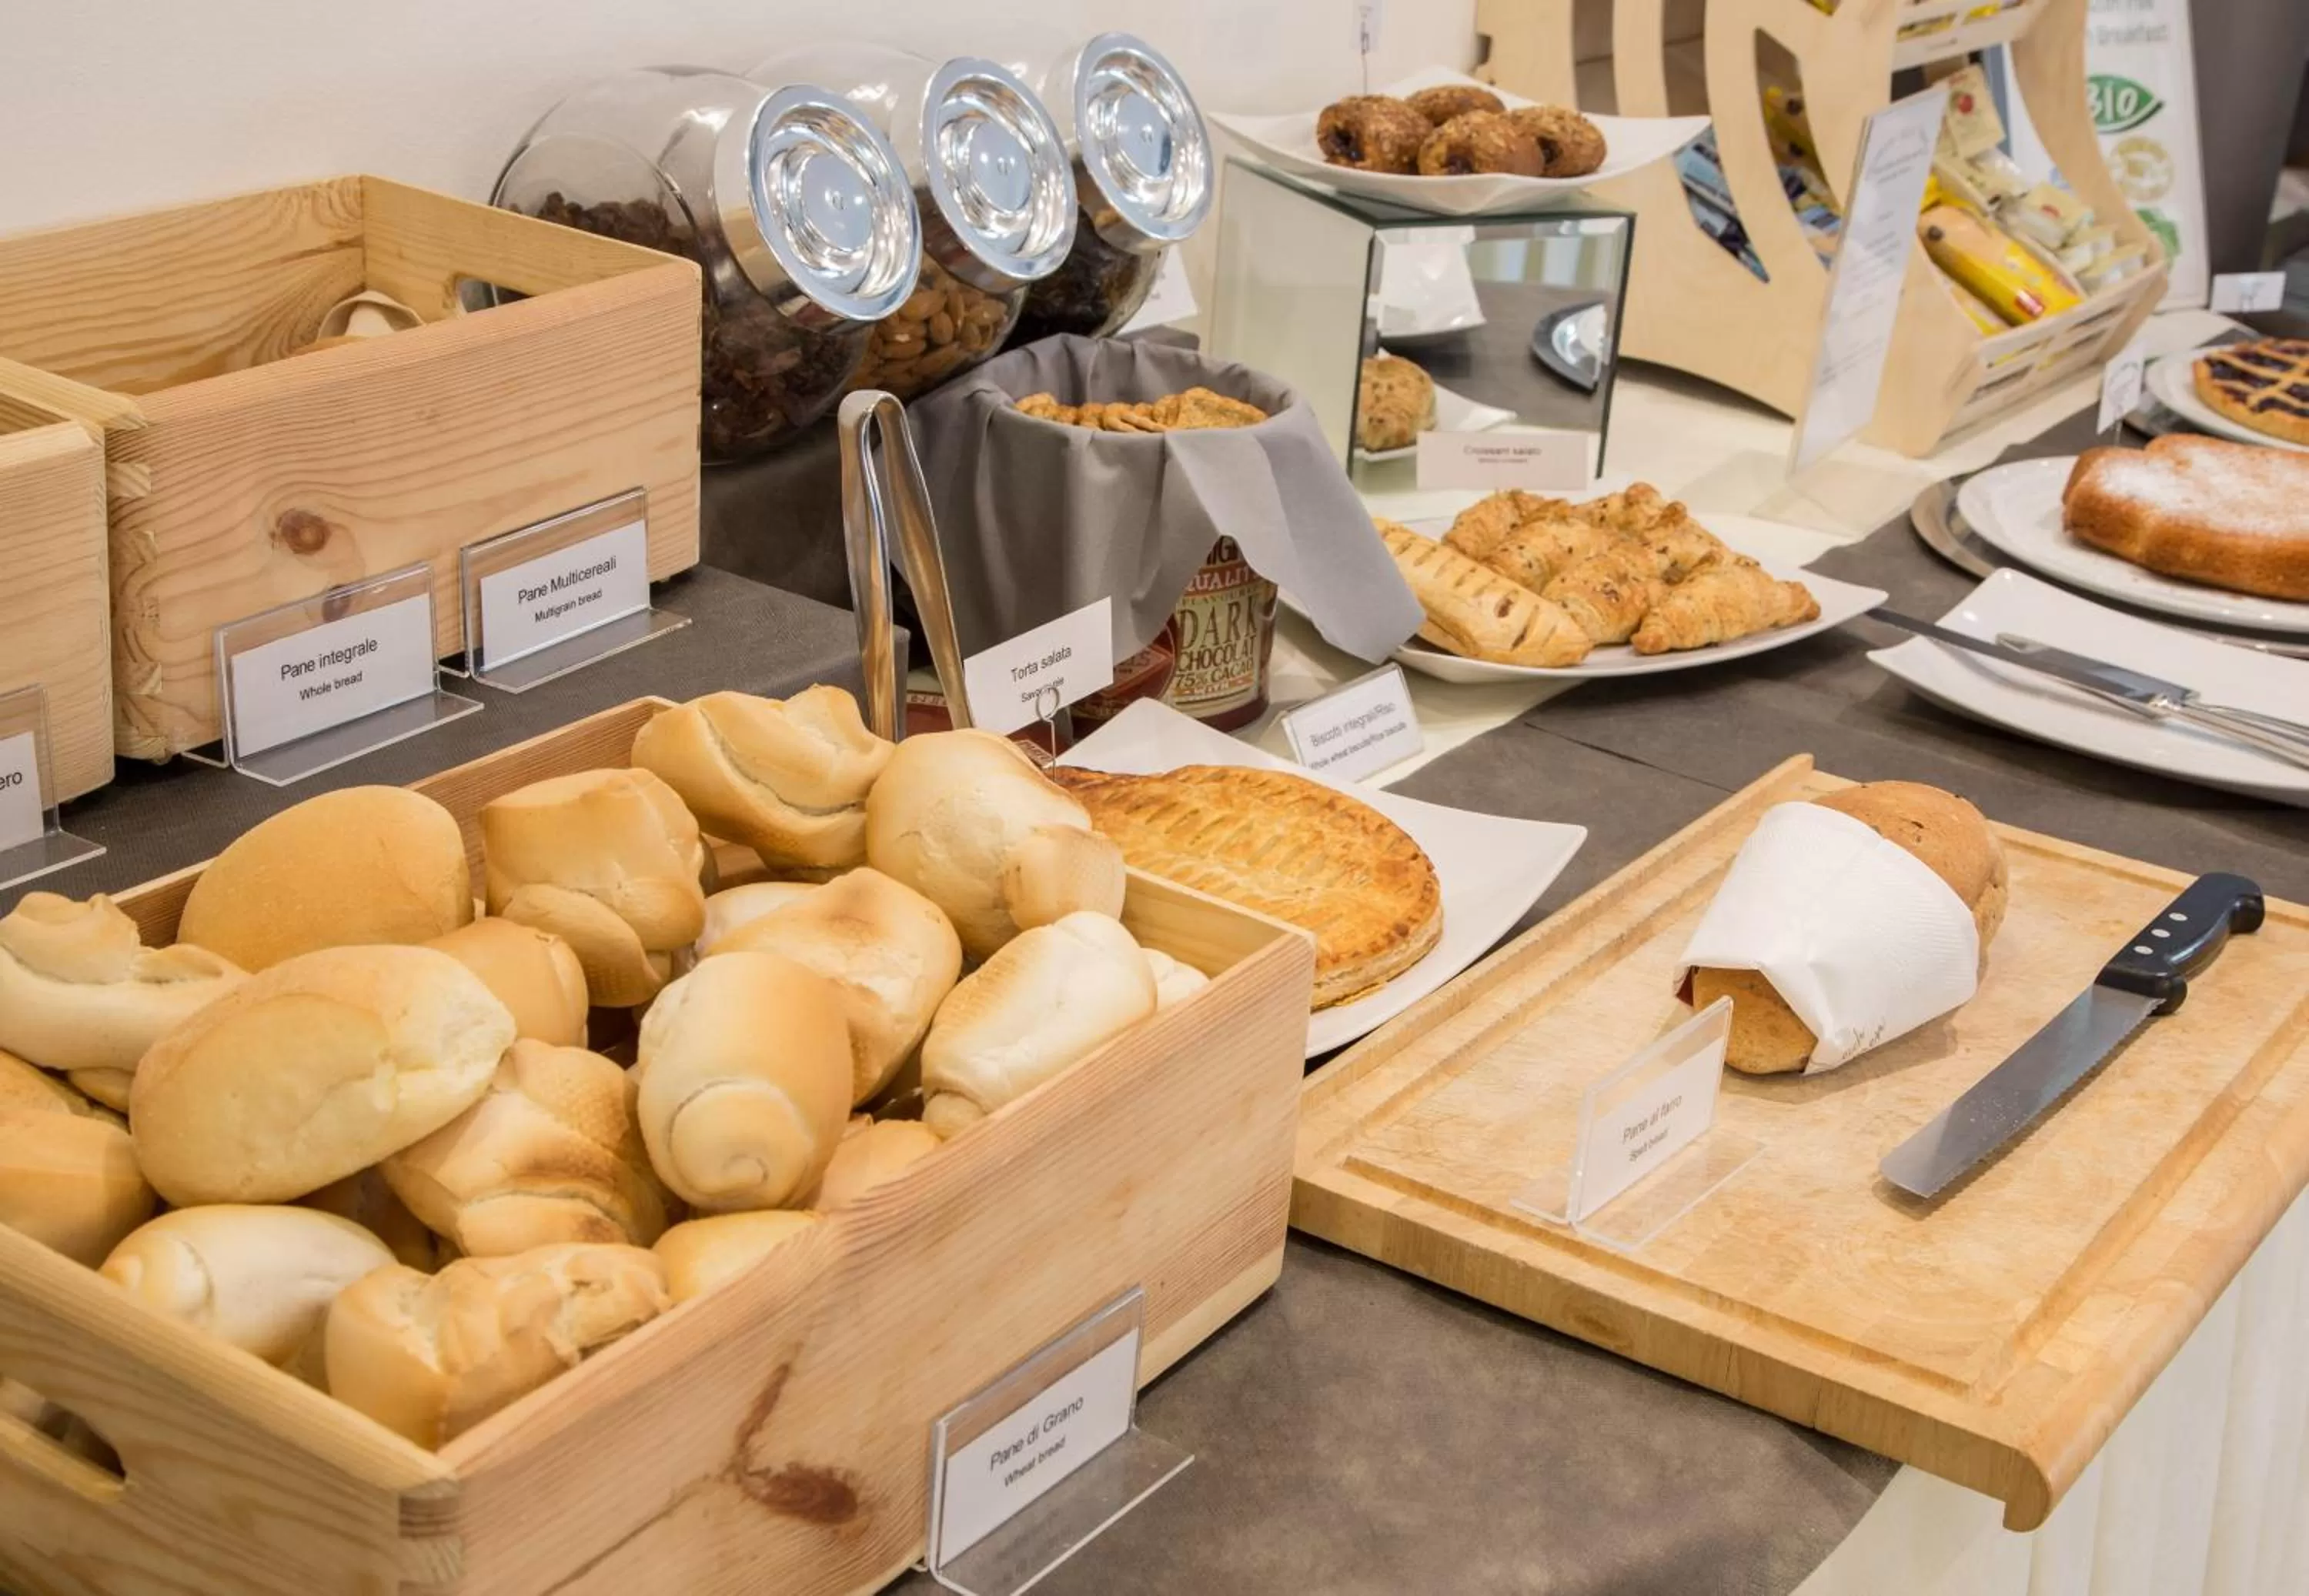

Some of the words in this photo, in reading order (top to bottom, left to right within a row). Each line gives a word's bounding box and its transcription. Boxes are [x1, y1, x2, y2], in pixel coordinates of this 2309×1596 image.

[2087, 80, 2138, 122] BIO
[518, 585, 548, 604] Pane
[550, 556, 617, 593] Multicereali
[1186, 566, 1259, 592] UALIT
[535, 599, 576, 623] Multigrain
[578, 588, 603, 606] bread
[1178, 596, 1257, 649] DARK
[280, 659, 315, 681] Pane
[319, 638, 378, 664] integrale
[1011, 663, 1038, 683] Torta
[1041, 646, 1072, 669] salata
[1175, 671, 1209, 688] 75%
[1211, 657, 1255, 683] CACAO
[1178, 636, 1256, 672] CHOCOLAT
[299, 683, 332, 700] Whole
[334, 671, 363, 689] bread
[1622, 1118, 1649, 1144] Pane
[991, 1438, 1024, 1472] Pane
[1027, 1424, 1039, 1446] di
[1043, 1397, 1084, 1433] Grano
[1004, 1457, 1036, 1487] Wheat
[1038, 1435, 1066, 1464] bread
